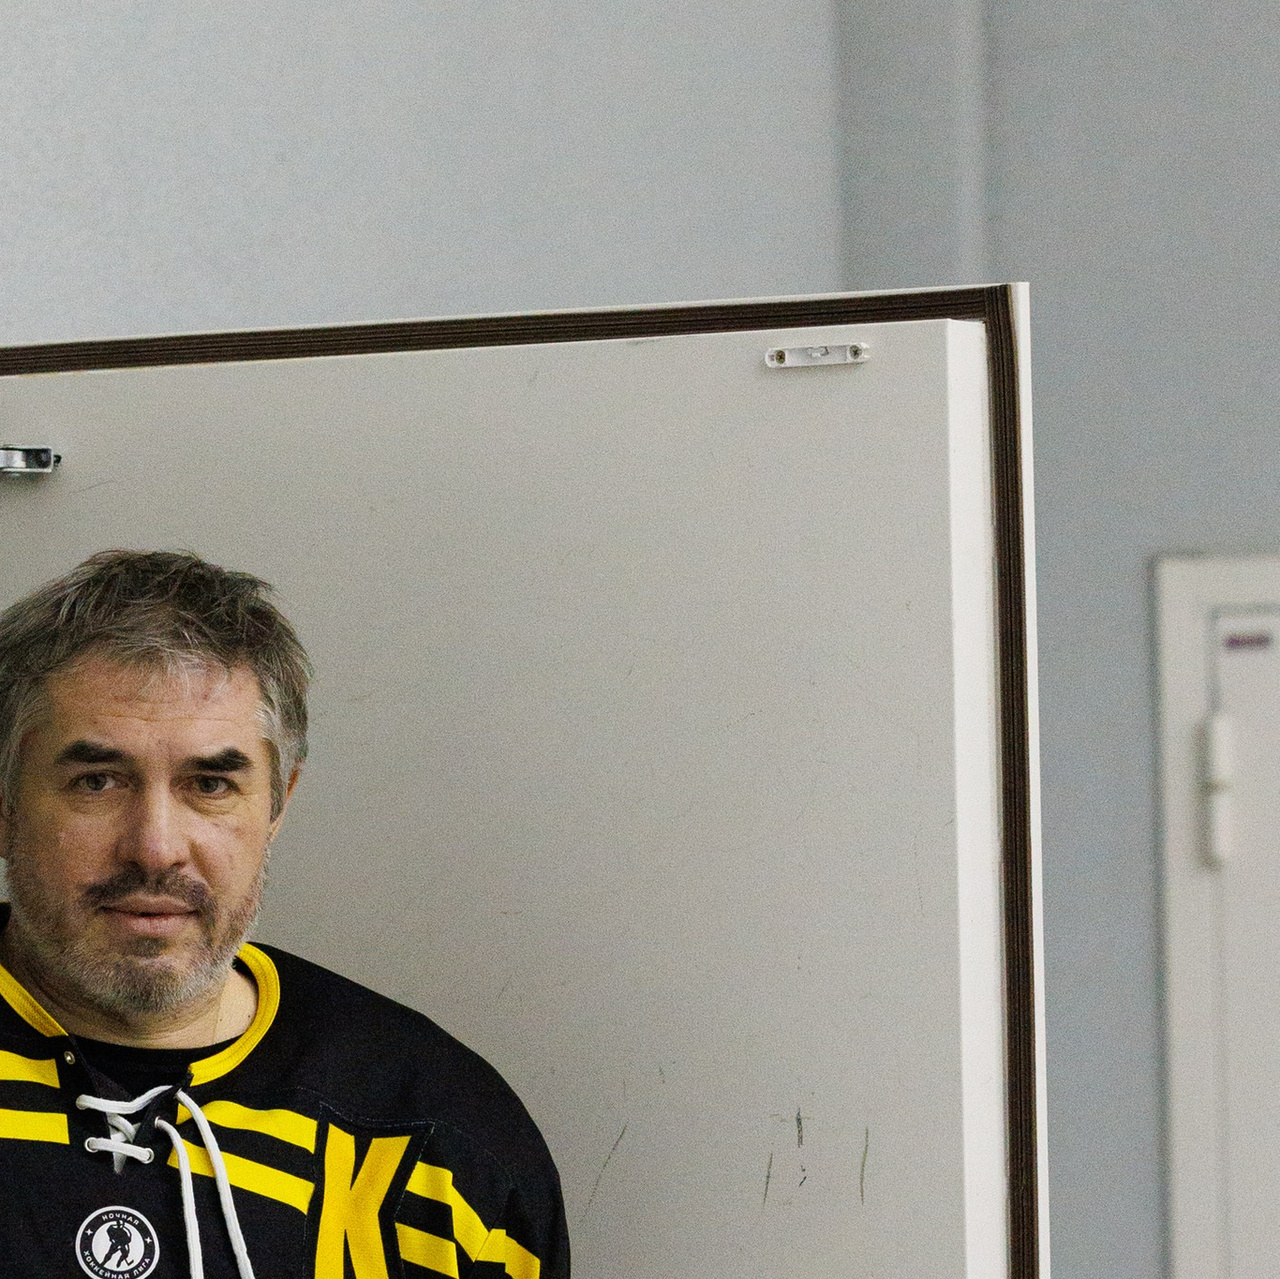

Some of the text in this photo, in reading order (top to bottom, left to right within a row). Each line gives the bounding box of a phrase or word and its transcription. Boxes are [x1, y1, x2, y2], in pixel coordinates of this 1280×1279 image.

[101, 1212, 140, 1225] НОЧНАЯ
[83, 1250, 152, 1279] ХОККЕЙНАЯ ЛИГА
